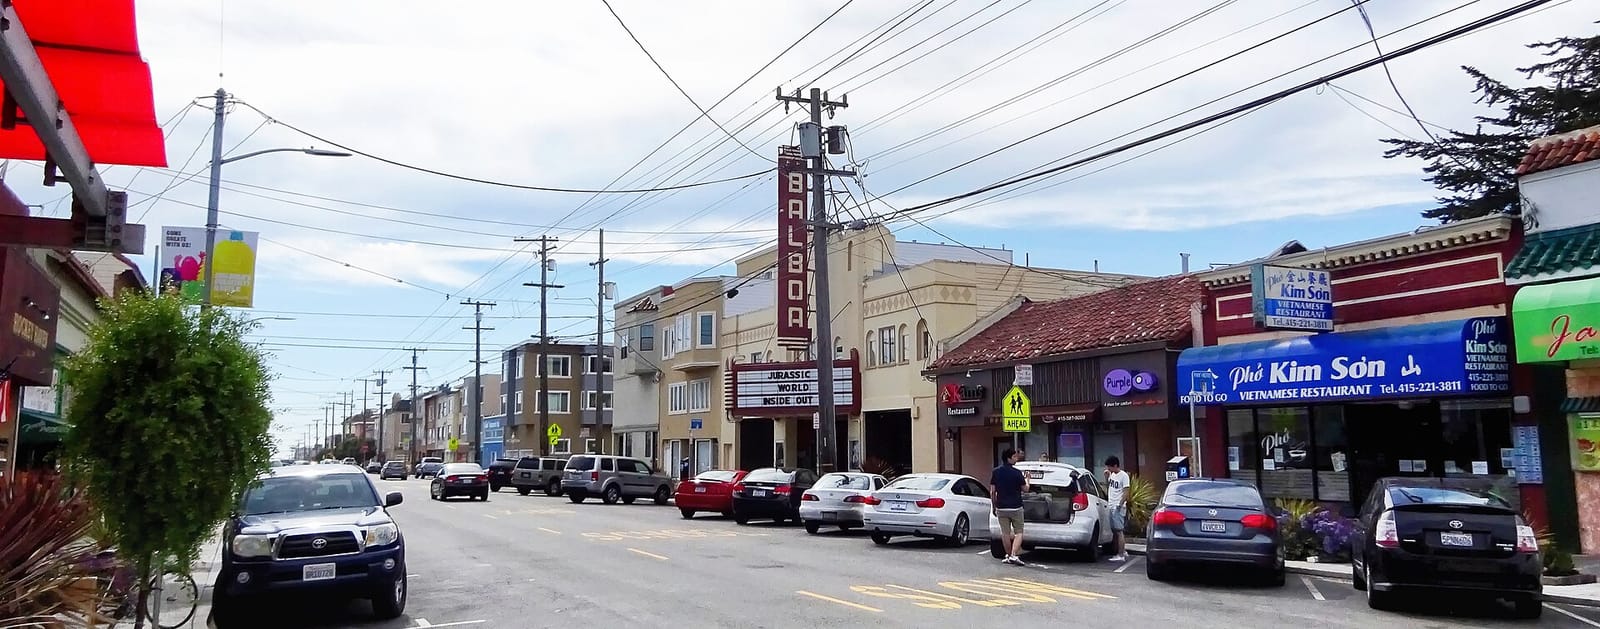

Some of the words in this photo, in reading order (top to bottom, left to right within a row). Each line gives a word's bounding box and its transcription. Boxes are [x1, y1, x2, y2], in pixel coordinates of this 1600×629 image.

[788, 171, 804, 328] BALBOA
[1281, 284, 1305, 298] Kim
[1277, 300, 1324, 310] VIETNAMESE
[1275, 308, 1327, 318] RESTAURANT
[1466, 340, 1486, 353] Kim
[1466, 354, 1506, 362] VIETNAMESE
[1269, 361, 1322, 384] Kim
[1330, 356, 1386, 380] Sơn
[1401, 354, 1422, 377] 山
[1464, 362, 1508, 370] RESTAURANT
[768, 371, 811, 380] JURASSIC
[778, 383, 809, 393] WORLD
[1106, 376, 1131, 390] Purple
[1470, 383, 1488, 391] FOOD
[1489, 383, 1498, 391] TO
[1214, 393, 1228, 402] GO
[1239, 388, 1298, 401] VIETNAMESE
[1300, 384, 1372, 398] RESTAURANT
[763, 396, 790, 406] INSIDE
[796, 396, 813, 405] OUT
[947, 407, 975, 416] Restaurant
[1007, 419, 1027, 429] AHEAD
